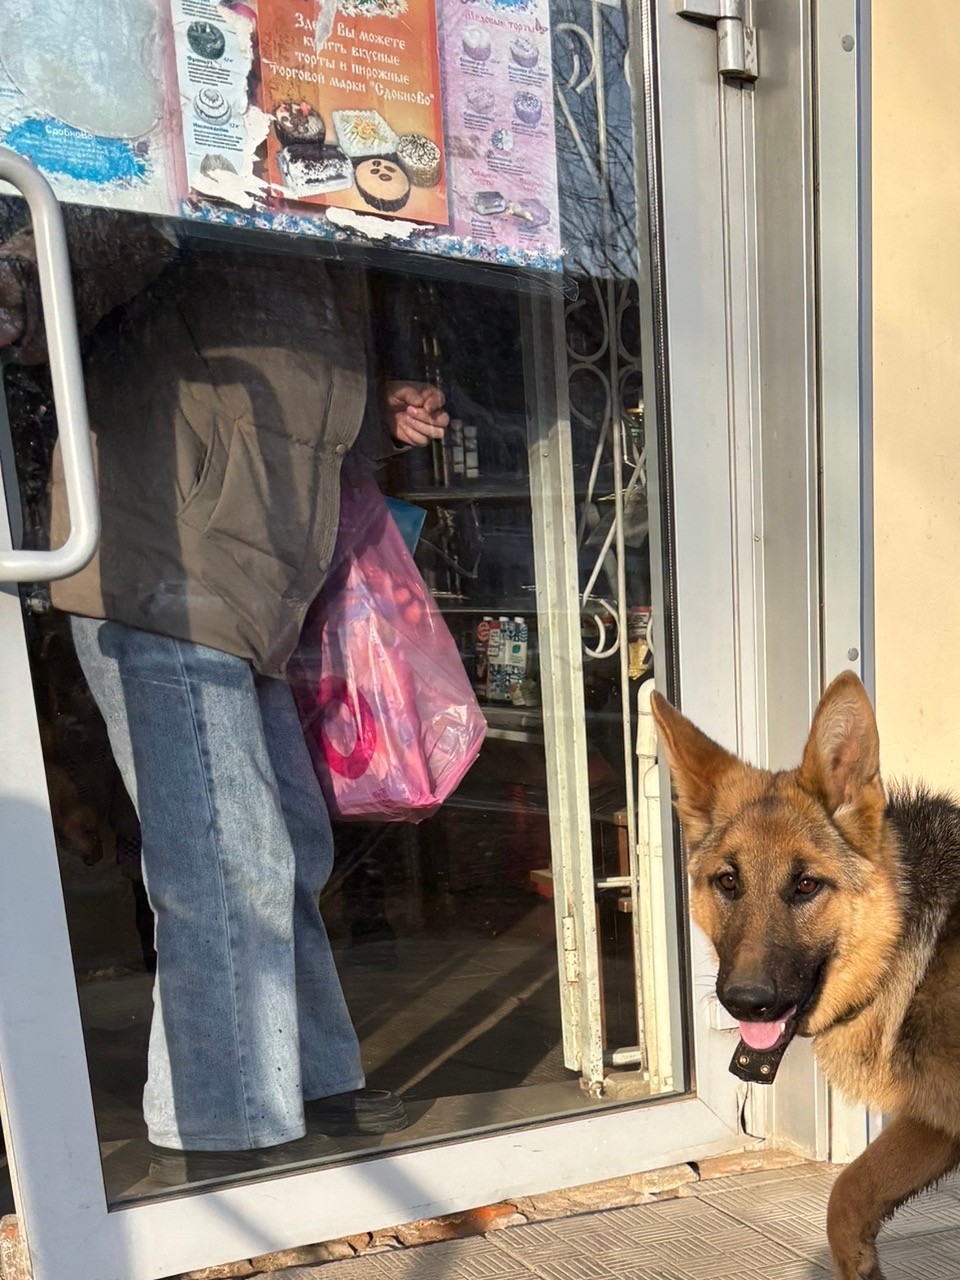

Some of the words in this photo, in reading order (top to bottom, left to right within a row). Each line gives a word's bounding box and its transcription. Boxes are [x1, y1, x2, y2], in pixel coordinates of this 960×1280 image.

[303, 35, 348, 54] куить
[351, 46, 401, 66] вкусные
[359, 31, 406, 50] можете
[269, 63, 325, 85] торговой
[329, 77, 366, 93] марки
[295, 51, 336, 70] торты
[339, 62, 348, 72] и
[351, 64, 410, 85] пирожные
